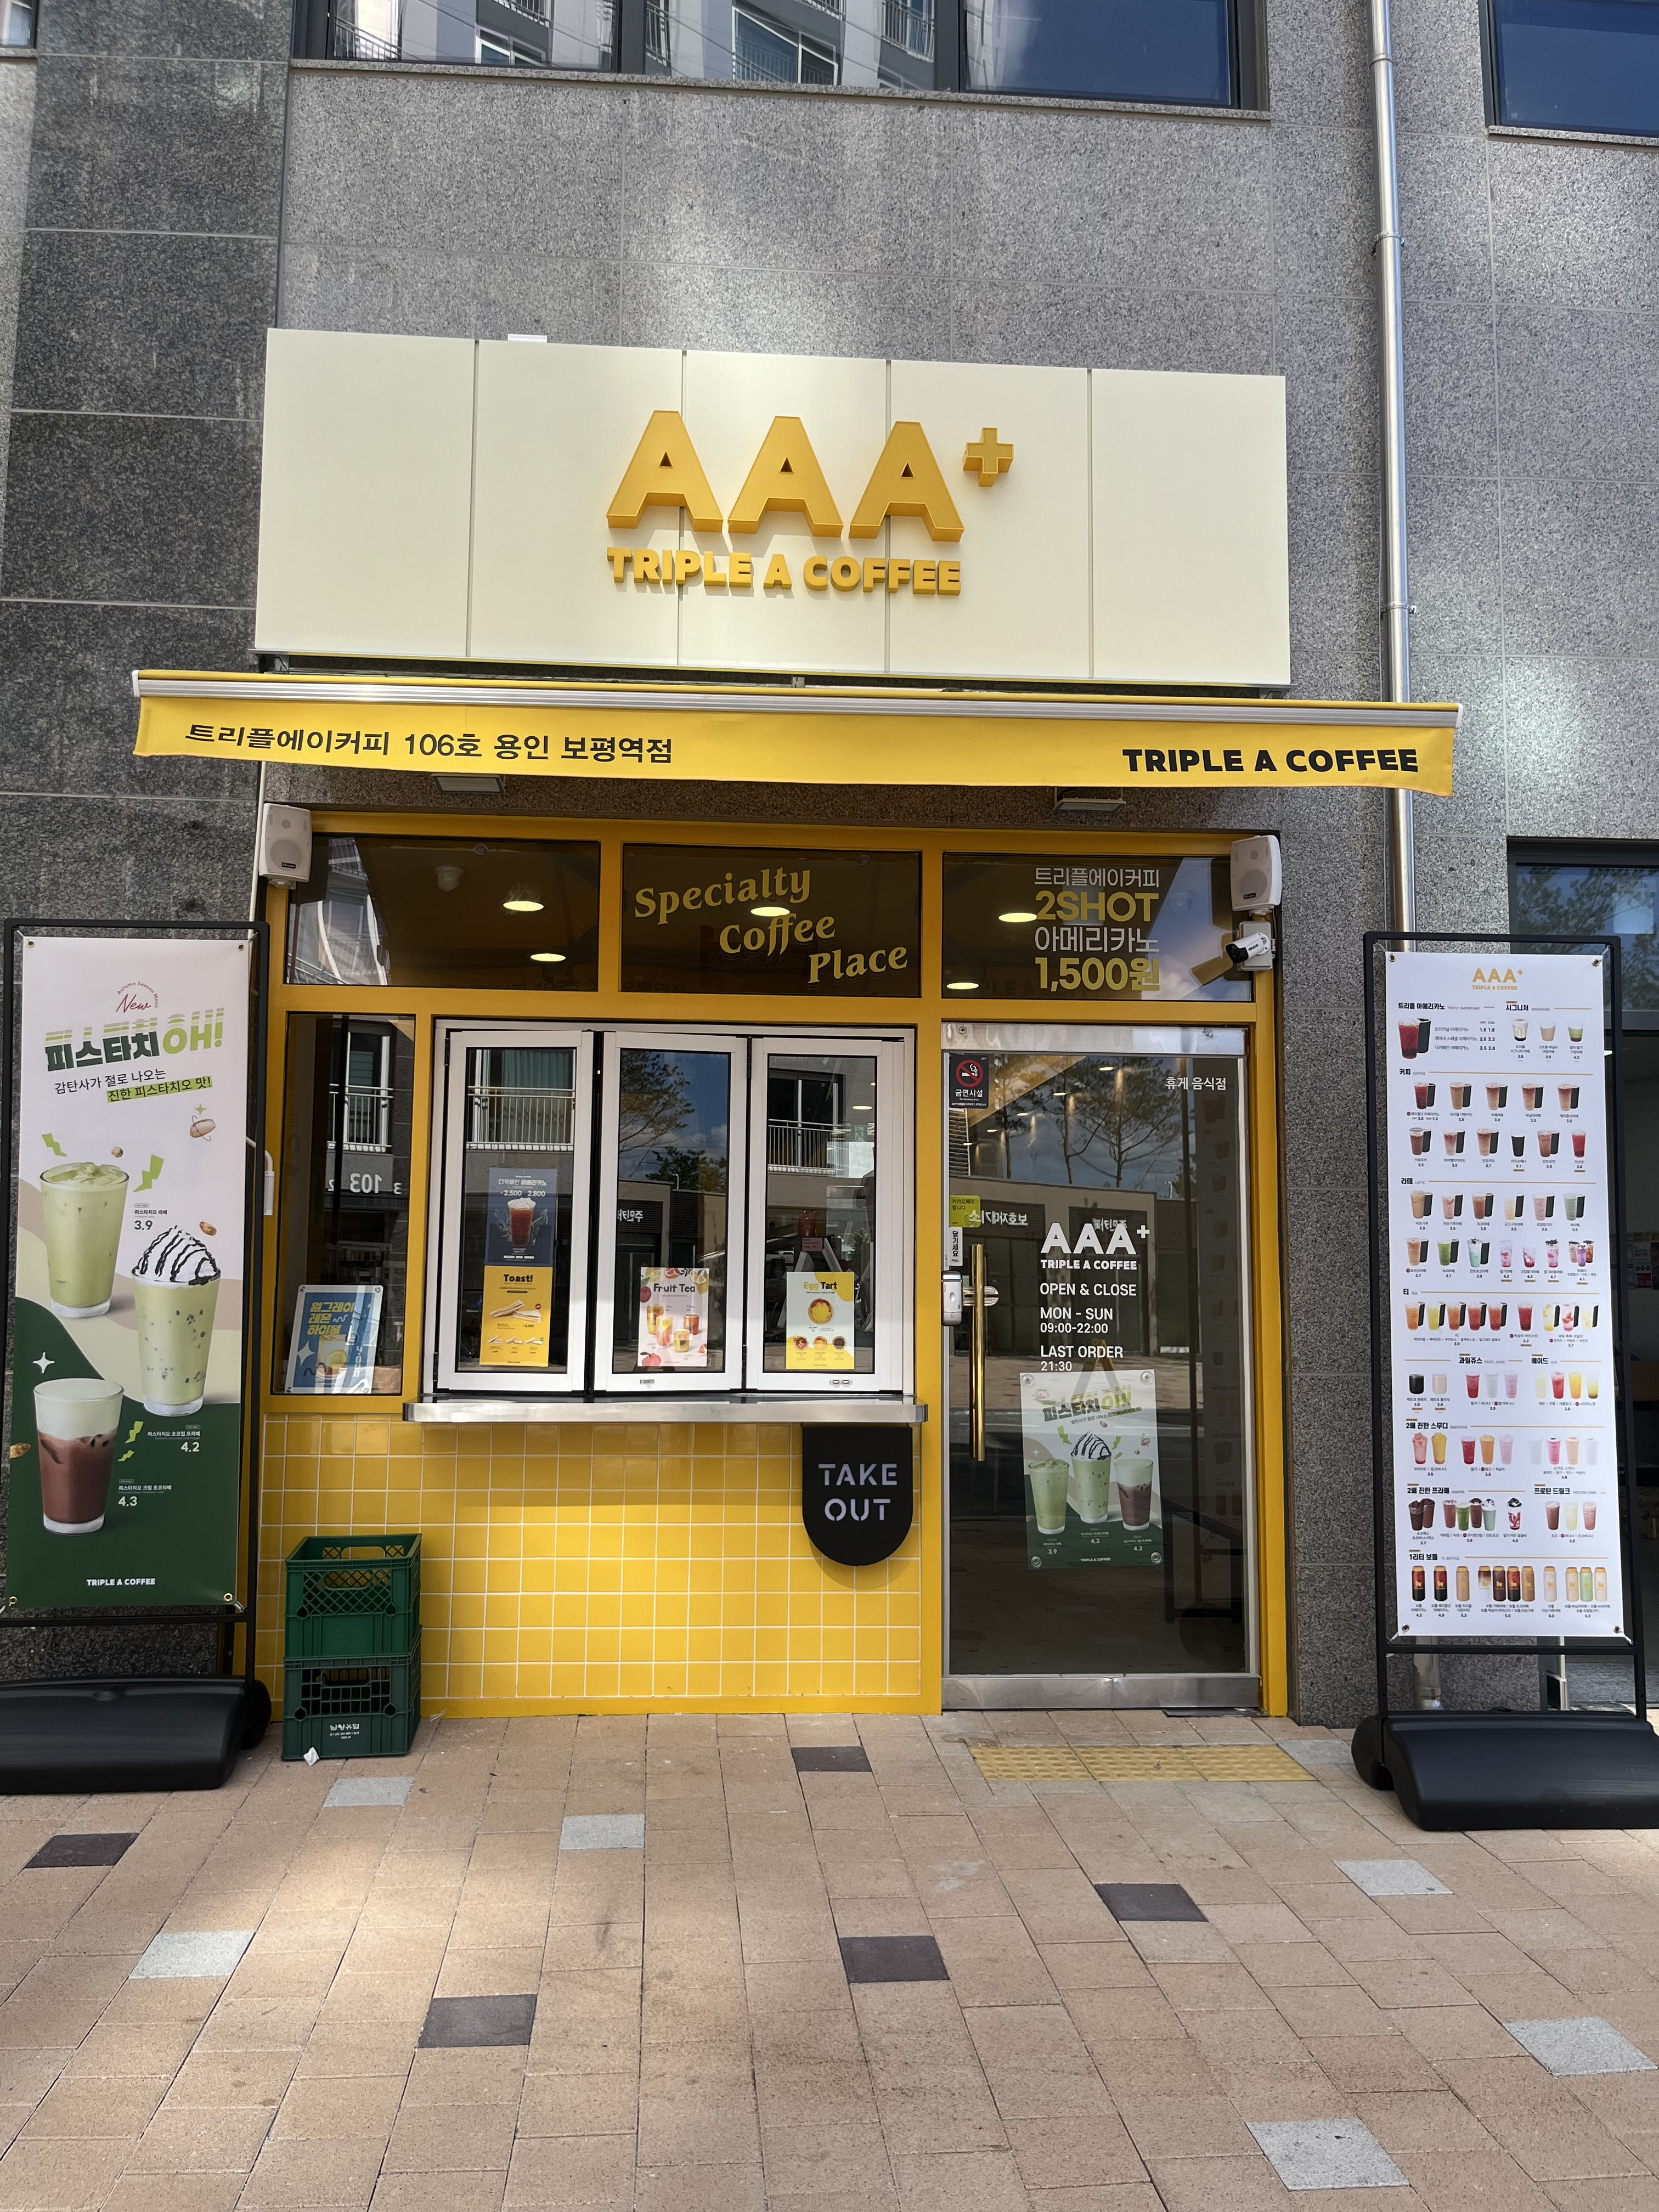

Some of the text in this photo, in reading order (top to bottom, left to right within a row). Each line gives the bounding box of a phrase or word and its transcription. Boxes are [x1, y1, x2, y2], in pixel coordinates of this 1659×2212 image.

[607, 547, 962, 595] TRIPLE A COFFEE
[185, 724, 673, 764] 트리플에이커피 106호 용인 보평역점
[1122, 749, 1419, 772] TRIPLE A COFFEE
[1035, 867, 1159, 888] 트리플에이커피
[635, 867, 810, 924] Specialty
[1035, 891, 1159, 922] 2SHOT
[719, 913, 836, 956] Coffee
[1035, 926, 1160, 952] 아메리카노
[808, 946, 908, 984] Place
[1035, 957, 1160, 991] 1,500원
[117, 982, 136, 995] Autumn
[138, 981, 154, 994] Season
[116, 994, 151, 1012] New
[55, 1069, 166, 1094] 감탄사가 절로 나오는
[1165, 1077, 1226, 1090] 휴게 음식점
[108, 1076, 212, 1102] 진한 피스타치오 맛!
[955, 1089, 983, 1097] 금연시설
[134, 1220, 153, 1230] 3.9
[1040, 1260, 1137, 1270] TRIPLE A COFFEE
[504, 1274, 533, 1282] Toast!
[653, 1283, 696, 1293] Fruit Tea
[803, 1282, 819, 1290] Egg
[1040, 1283, 1137, 1296] OPEN & CLOSE
[309, 1302, 356, 1312] 얼그레이
[1040, 1307, 1071, 1319] MON
[1086, 1307, 1113, 1320] SUN
[308, 1313, 332, 1323] 레몬
[1040, 1322, 1108, 1334] 09:00-22:00
[1041, 1345, 1124, 1358] LAST ORDER
[1041, 1361, 1072, 1372] 21:30
[181, 1442, 200, 1452] 4.2
[818, 1464, 897, 1486] TAKE
[118, 1496, 137, 1506] 4.3
[825, 1498, 891, 1521] OUT
